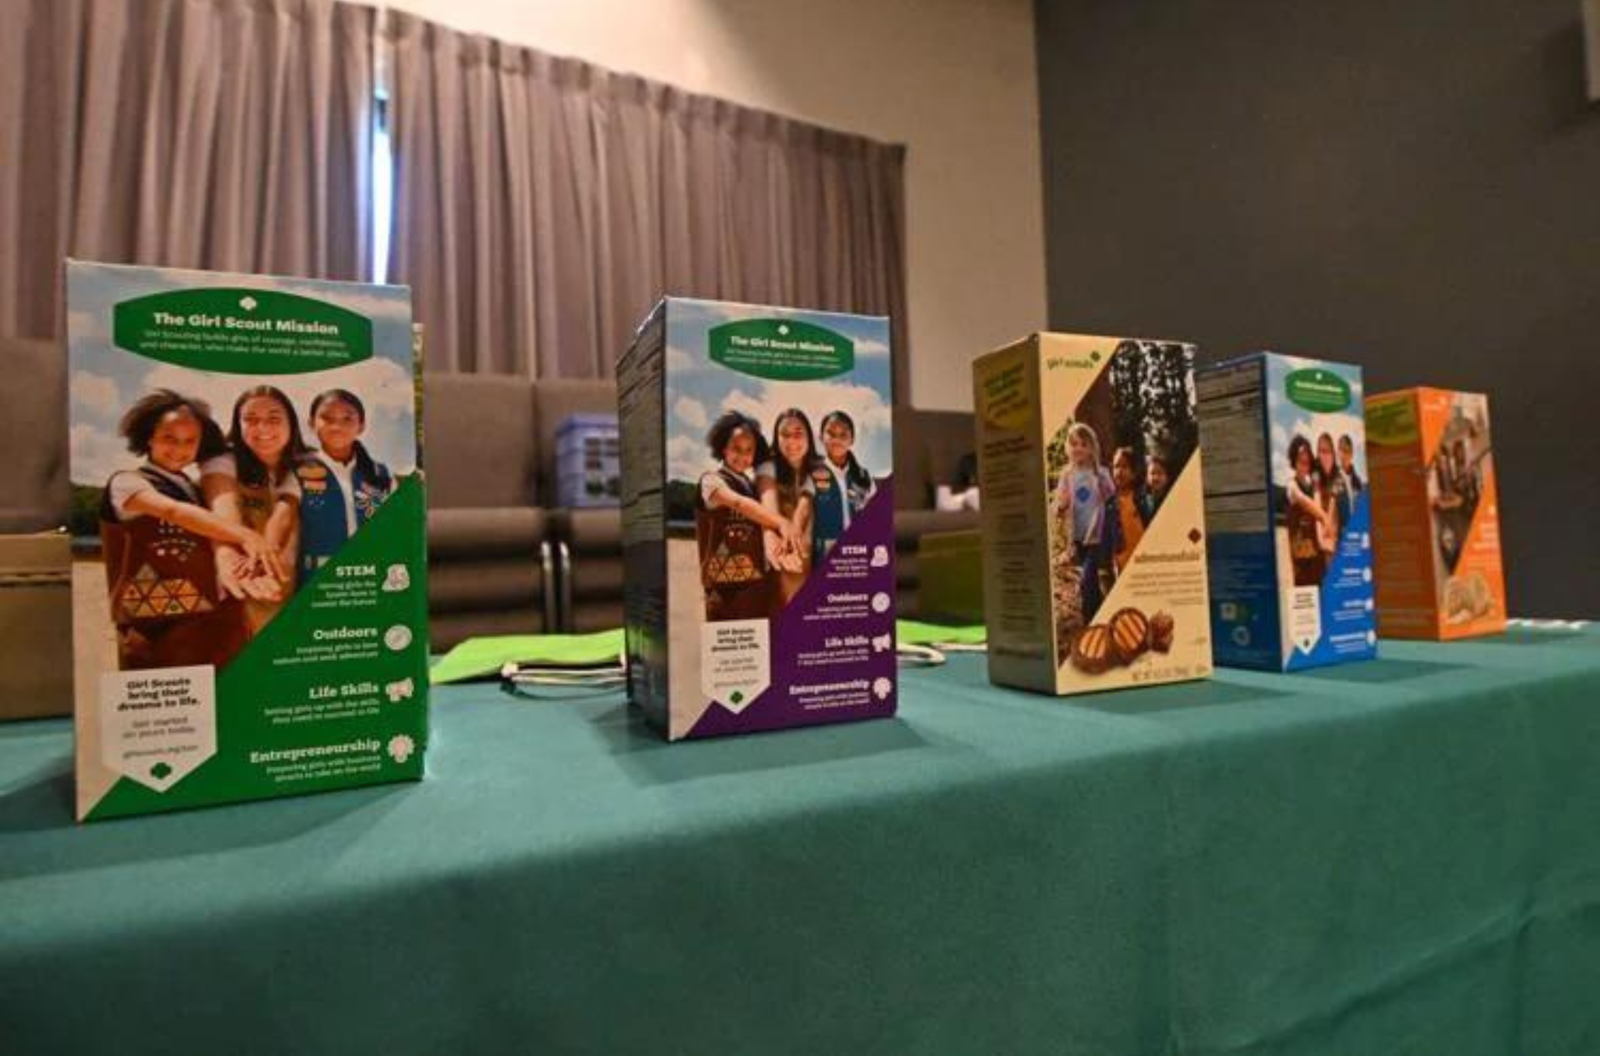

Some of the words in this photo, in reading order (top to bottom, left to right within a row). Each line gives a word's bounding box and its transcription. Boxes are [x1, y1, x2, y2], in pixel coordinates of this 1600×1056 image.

[153, 311, 186, 327] The
[188, 314, 222, 328] Girl
[225, 316, 273, 332] Scout
[276, 319, 339, 336] Mission
[336, 564, 377, 577] STEM
[313, 625, 379, 641] Outdoors
[825, 636, 843, 649] Life
[126, 678, 150, 691] Girl
[308, 684, 339, 700] Life
[341, 680, 380, 697] Skills
[127, 689, 160, 701] bring
[161, 686, 190, 698] their
[250, 736, 381, 764] Entrepreneurship
